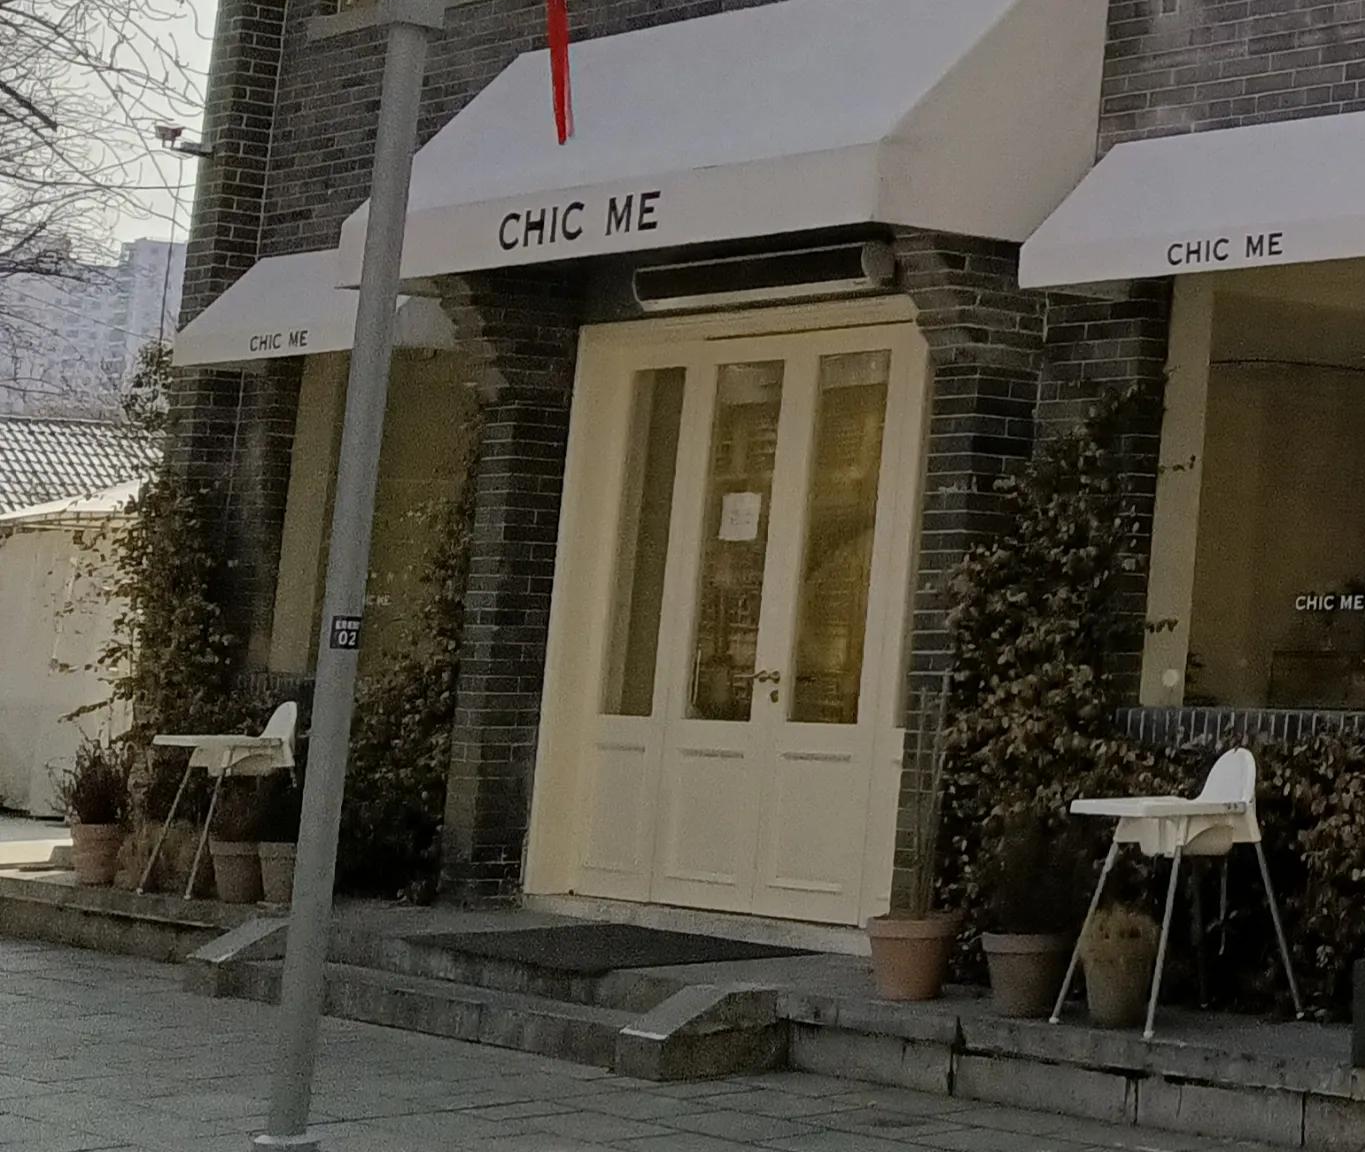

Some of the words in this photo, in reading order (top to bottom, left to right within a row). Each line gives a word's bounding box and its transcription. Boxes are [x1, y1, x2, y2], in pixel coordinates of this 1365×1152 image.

[499, 201, 584, 250] CHIC
[605, 190, 661, 236] ME
[1167, 238, 1230, 266] CHIC
[1245, 232, 1283, 259] ME
[250, 333, 282, 352] CHIC
[289, 330, 308, 347] ME
[1295, 595, 1335, 611] CHIC
[1339, 594, 1365, 610] ME
[338, 630, 357, 646] 02
